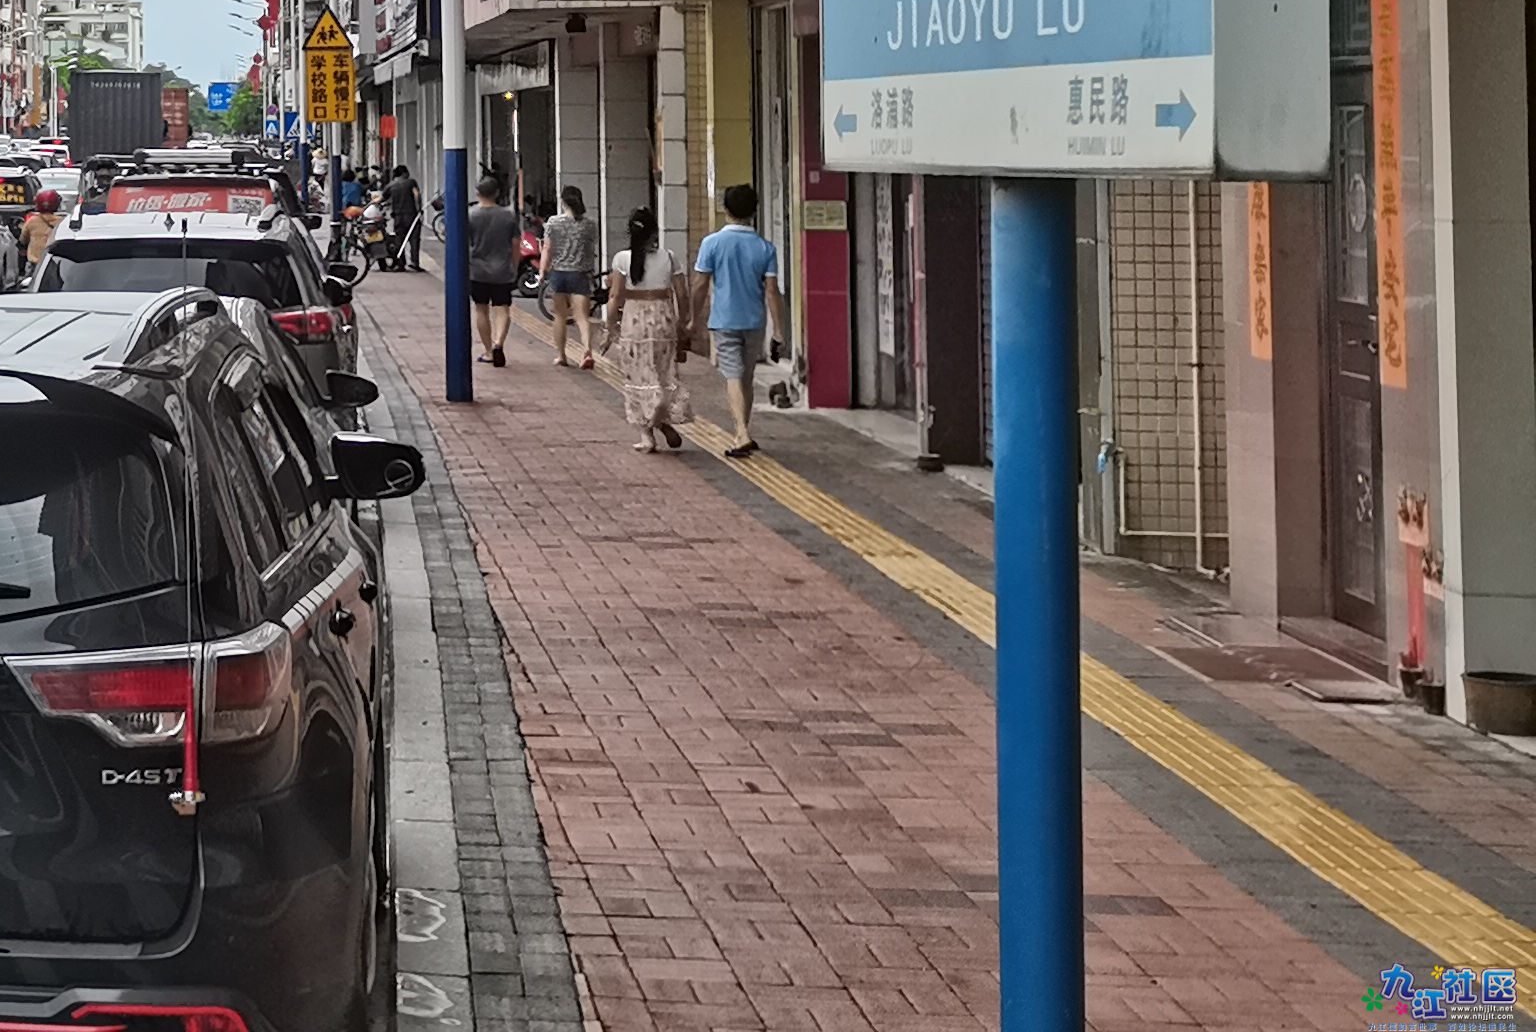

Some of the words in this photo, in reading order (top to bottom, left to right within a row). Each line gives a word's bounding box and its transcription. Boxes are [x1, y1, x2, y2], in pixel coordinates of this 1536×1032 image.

[311, 54, 327, 119] 学校路口
[333, 53, 350, 119] 车辆慢行
[1066, 73, 1129, 126] 惠民路
[1110, 136, 1125, 156] LU
